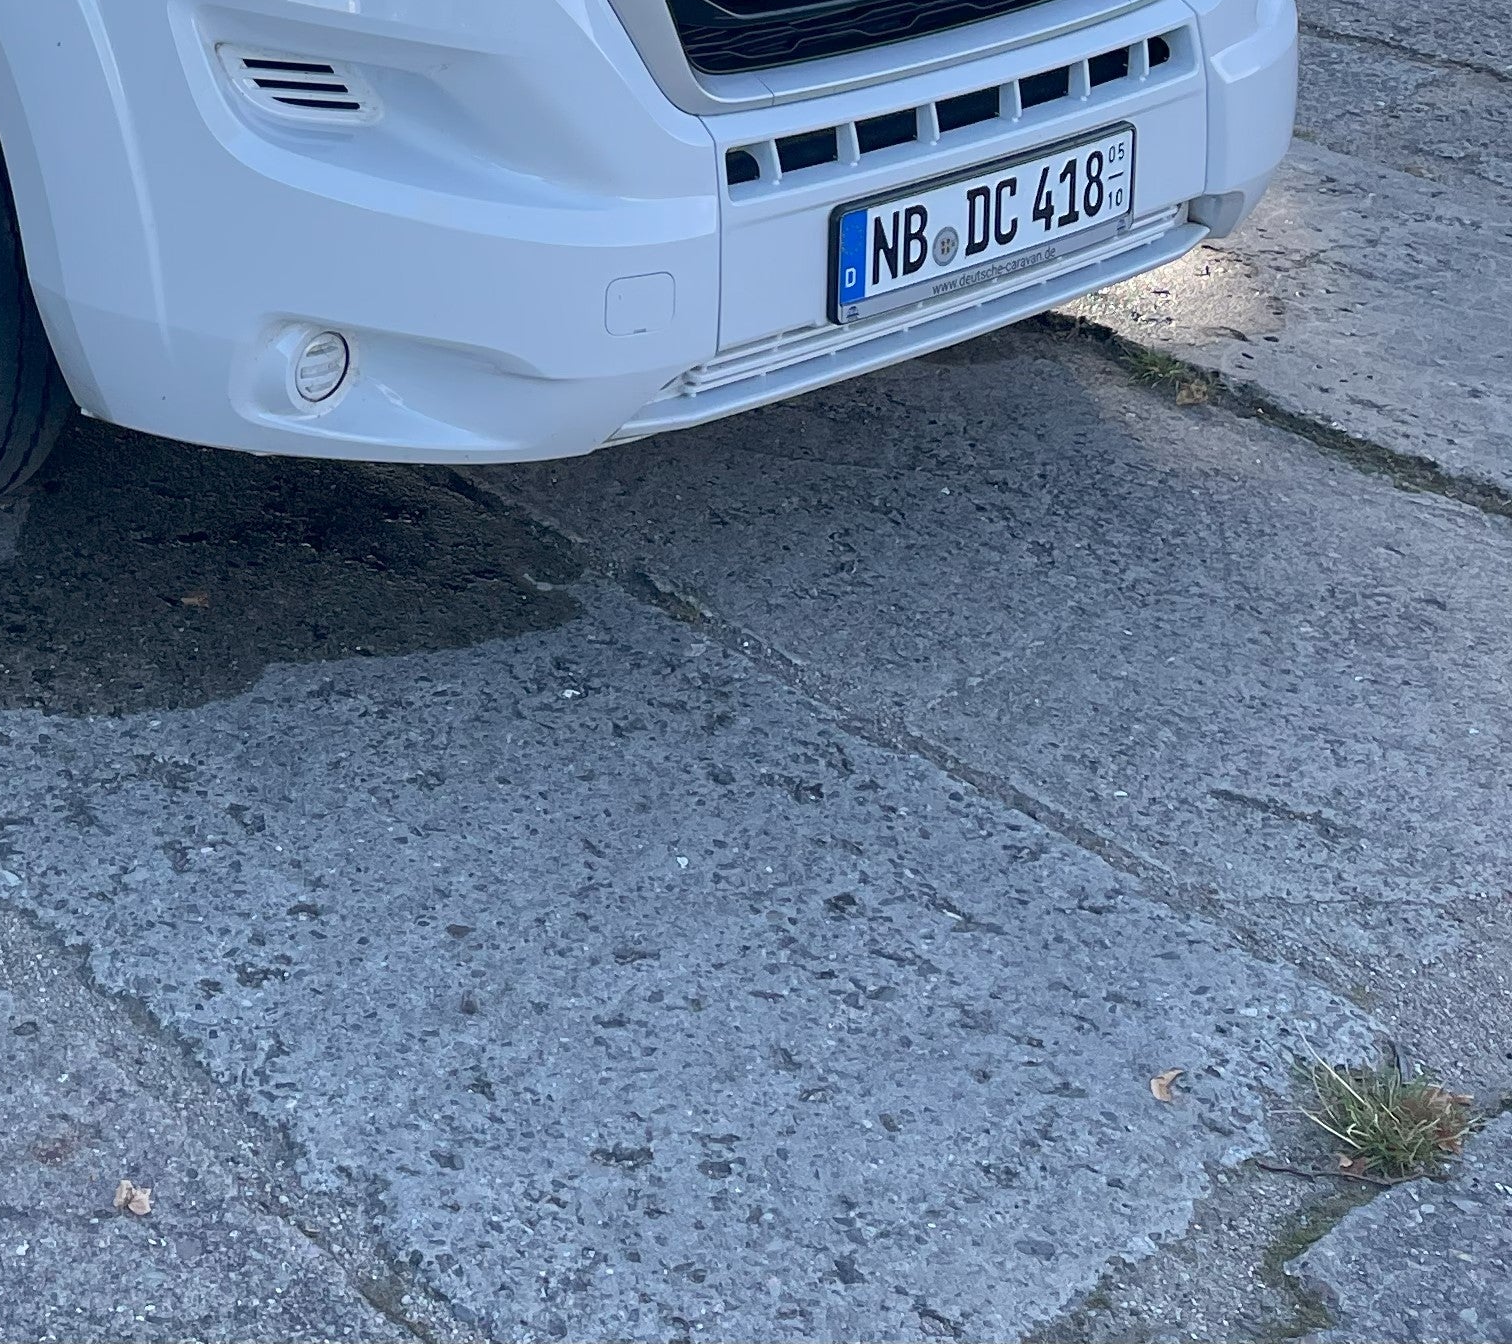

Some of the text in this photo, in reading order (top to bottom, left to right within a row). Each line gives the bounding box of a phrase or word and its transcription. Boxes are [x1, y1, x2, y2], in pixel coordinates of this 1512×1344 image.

[1108, 141, 1125, 164] 05
[1108, 187, 1123, 210] 10
[872, 150, 1104, 286] NB DC 418
[845, 267, 857, 288] D
